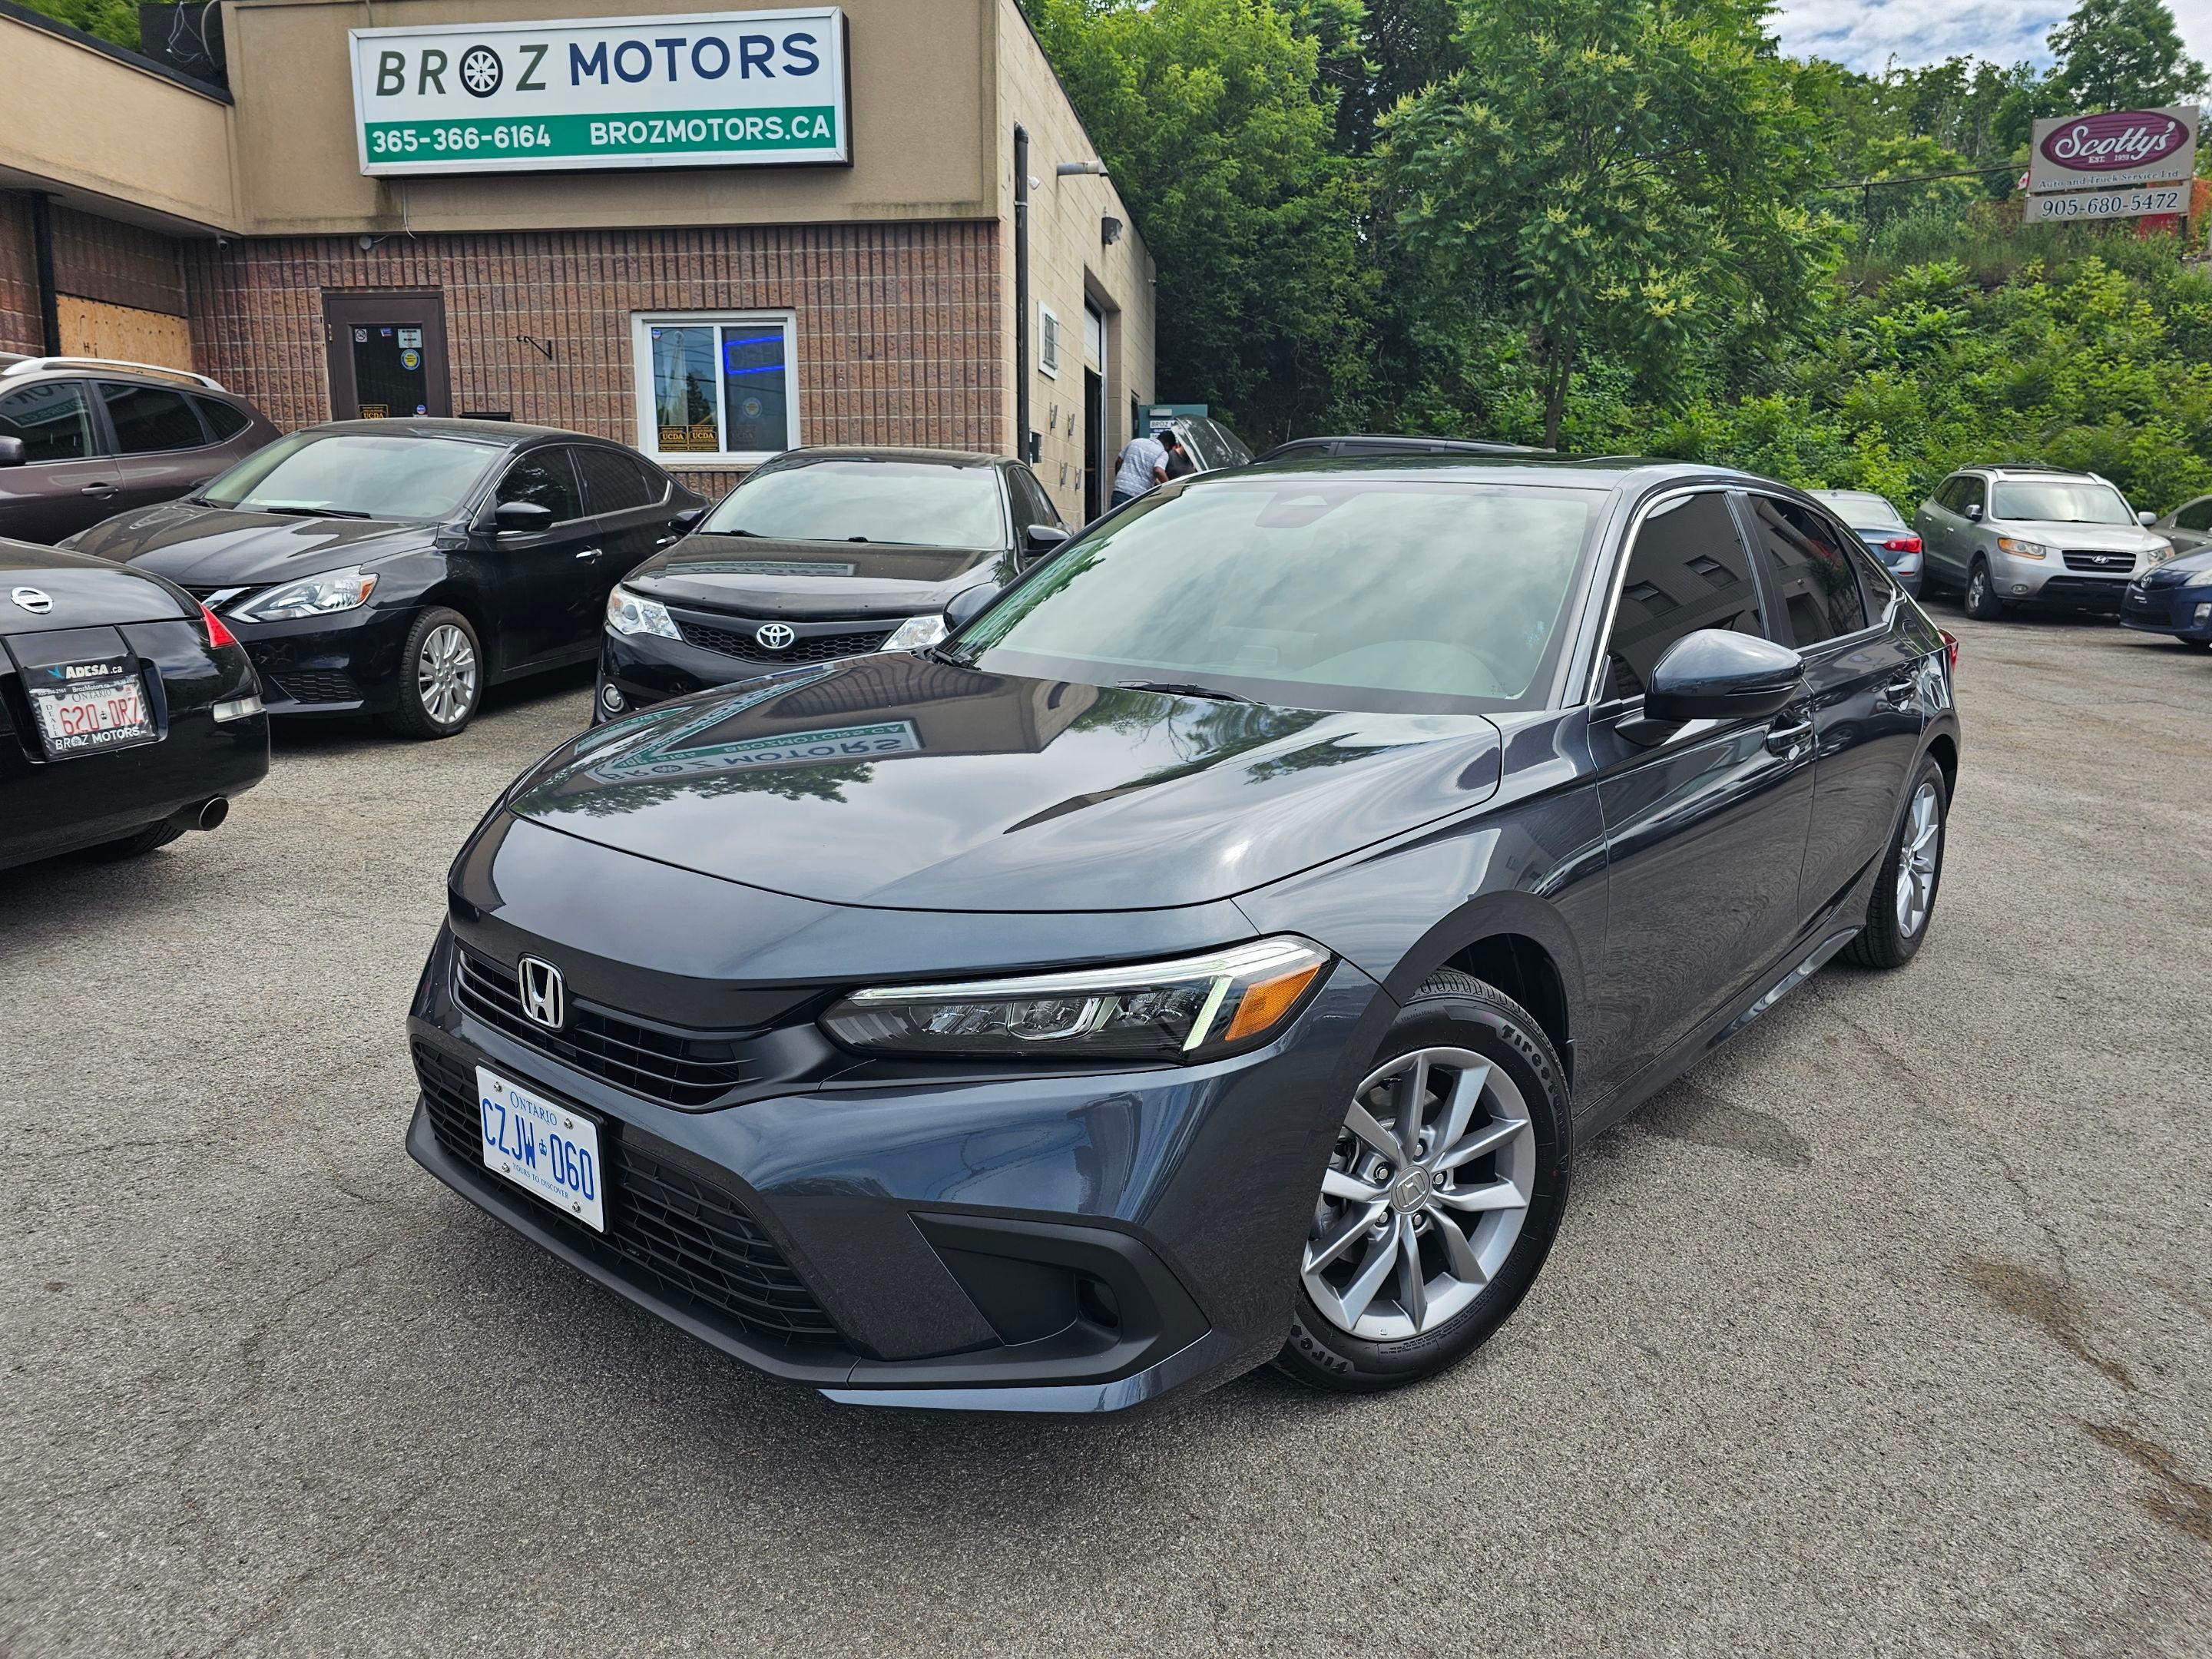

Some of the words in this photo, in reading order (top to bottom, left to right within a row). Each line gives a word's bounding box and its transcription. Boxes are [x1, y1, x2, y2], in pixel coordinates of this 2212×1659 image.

[376, 44, 549, 98] BROZ
[569, 32, 820, 86] MOTORS
[372, 124, 551, 154] 365-366-6164
[590, 114, 831, 146] BROZMOTORS.CA
[2039, 180, 2064, 190] Auto
[2066, 177, 2086, 187] and
[2090, 174, 2118, 185] Truck
[2121, 171, 2157, 182] Service
[2041, 192, 2179, 218] 905-680-5472
[72, 689, 111, 703] ONTARIO
[55, 733, 90, 750] BROZ
[92, 726, 141, 743] MOTORS
[510, 1091, 557, 1127] ONTARIO
[512, 1162, 531, 1179] YOURS
[531, 1173, 540, 1184] TO
[541, 1178, 569, 1200] DISCOVER
